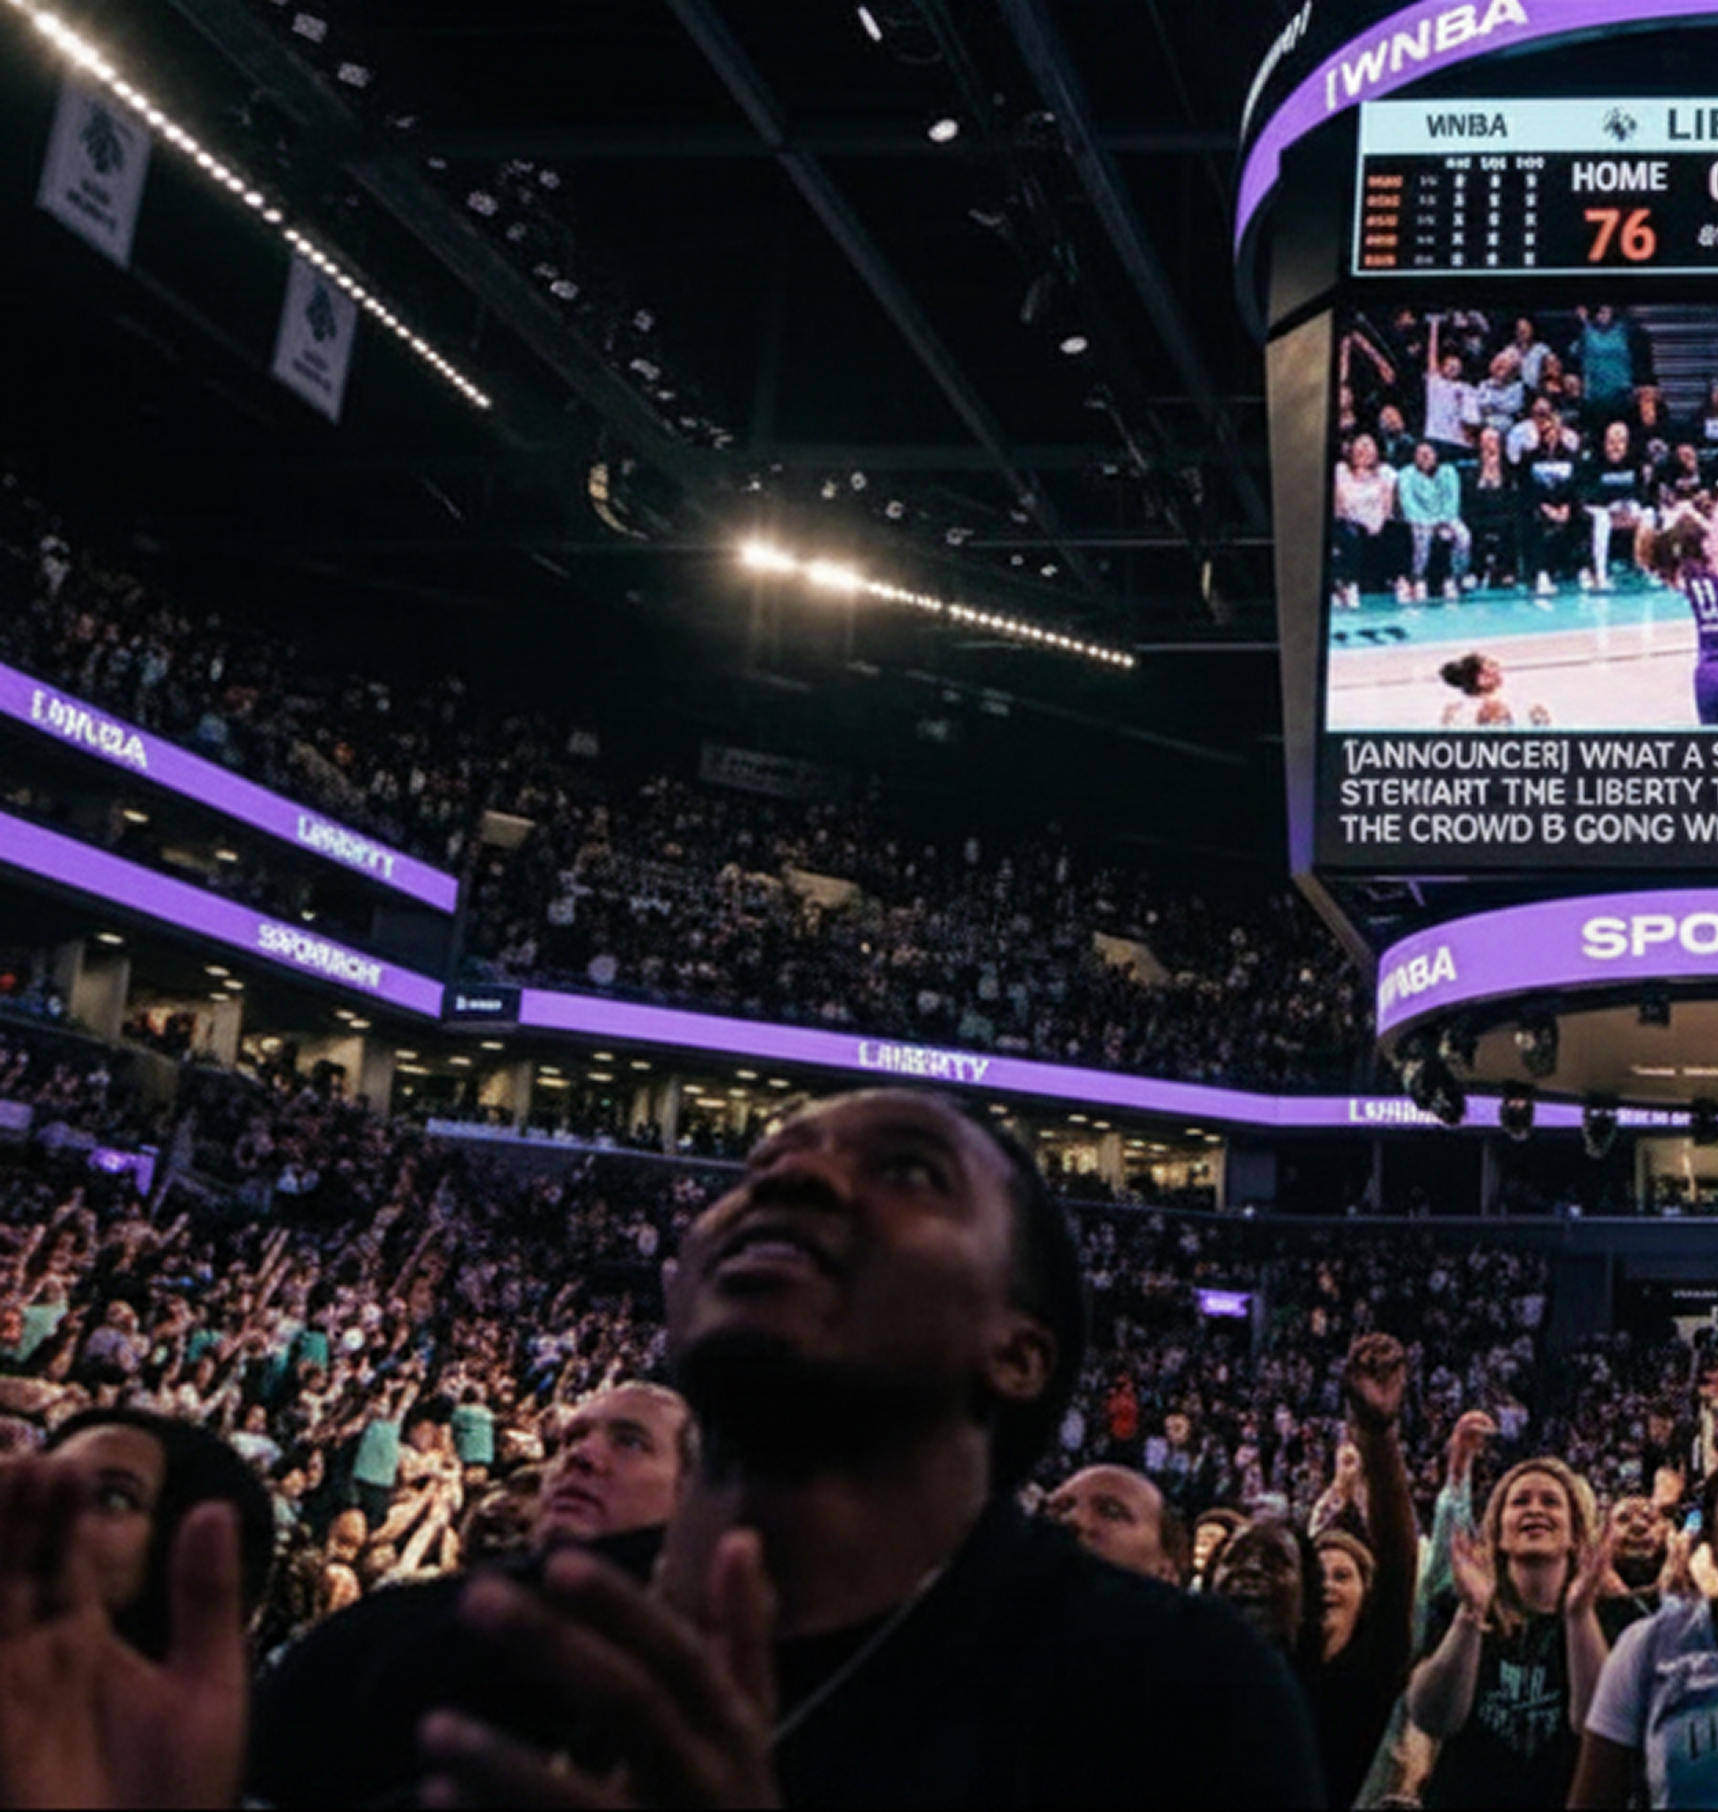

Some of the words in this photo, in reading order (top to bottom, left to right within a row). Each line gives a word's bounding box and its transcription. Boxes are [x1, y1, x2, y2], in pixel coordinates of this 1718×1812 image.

[1571, 161, 1669, 193] HOME
[1583, 207, 1658, 262] 76
[1682, 741, 1706, 770] A
[1576, 777, 1704, 806] LIBERTY
[1339, 814, 1402, 843] THE
[1409, 813, 1534, 844] CROWD
